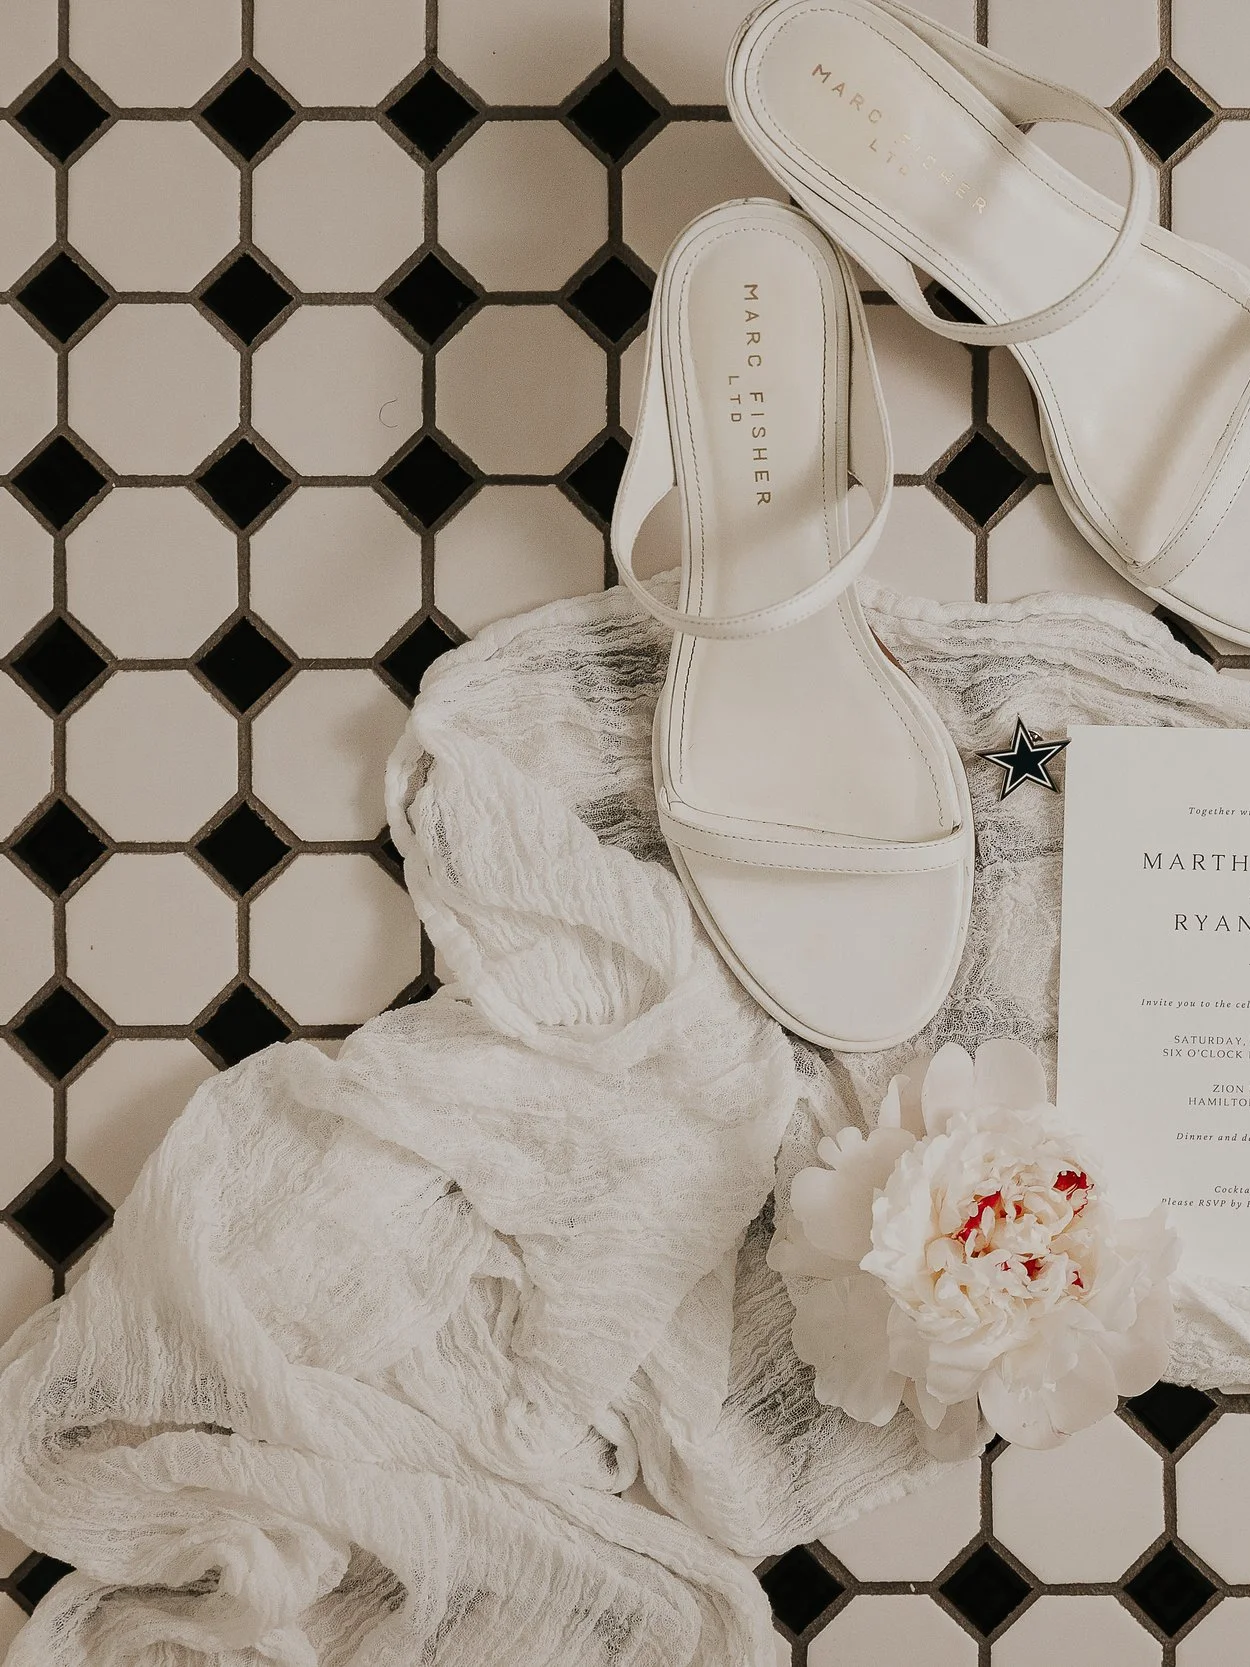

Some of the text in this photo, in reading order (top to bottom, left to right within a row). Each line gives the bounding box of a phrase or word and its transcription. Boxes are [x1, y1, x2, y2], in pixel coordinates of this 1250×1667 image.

[811, 63, 883, 124] MARC
[728, 375, 743, 424] LTD
[743, 283, 772, 506] MARC FISHER
[1188, 806, 1236, 818] Together
[1141, 998, 1173, 1008] Invite
[1176, 1000, 1196, 1009] you
[1200, 1000, 1211, 1008] to
[1215, 999, 1231, 1008] the
[1174, 1035, 1246, 1046] SATURDAY,
[1163, 1048, 1182, 1057] SIX
[1187, 1049, 1243, 1059] O'CLOCK
[1212, 1084, 1244, 1094] ZION
[1176, 1132, 1213, 1141] Dinner
[1217, 1133, 1238, 1142] and
[1198, 1198, 1227, 1208] RSVP
[1230, 1199, 1242, 1209] by
